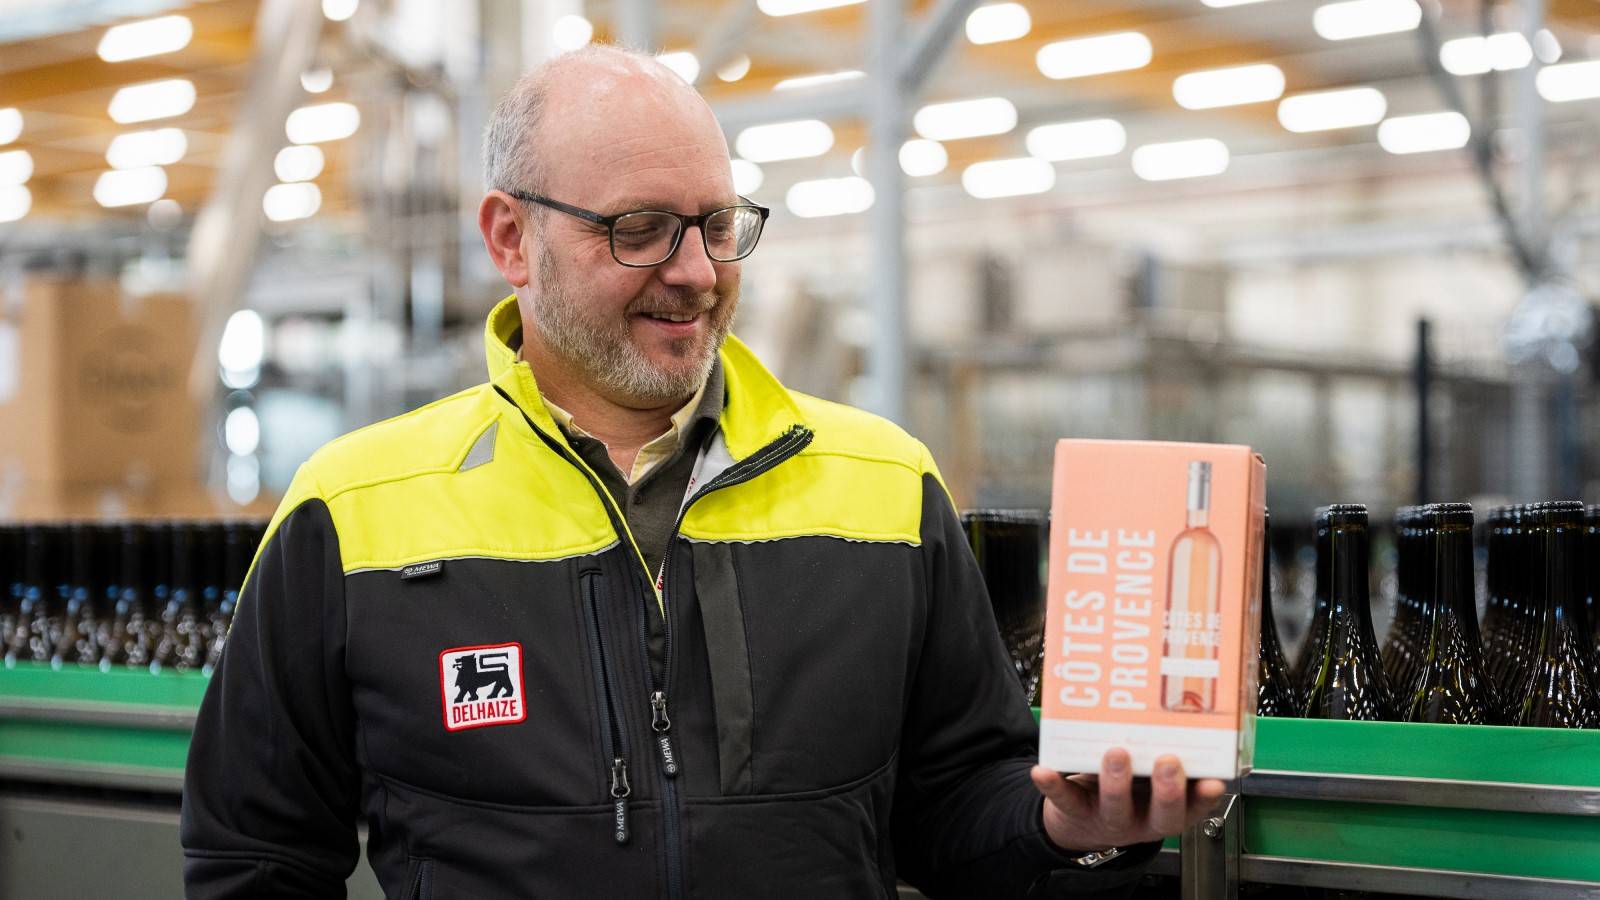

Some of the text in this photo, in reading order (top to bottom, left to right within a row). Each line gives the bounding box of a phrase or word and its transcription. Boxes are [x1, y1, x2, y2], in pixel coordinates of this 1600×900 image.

[413, 561, 439, 573] MEWA
[1053, 527, 1110, 708] CÔTES DE
[1108, 527, 1156, 710] PROVENCE
[452, 700, 518, 724] DELHAIZE
[660, 737, 674, 764] MEWA
[616, 801, 625, 831] MEWA
